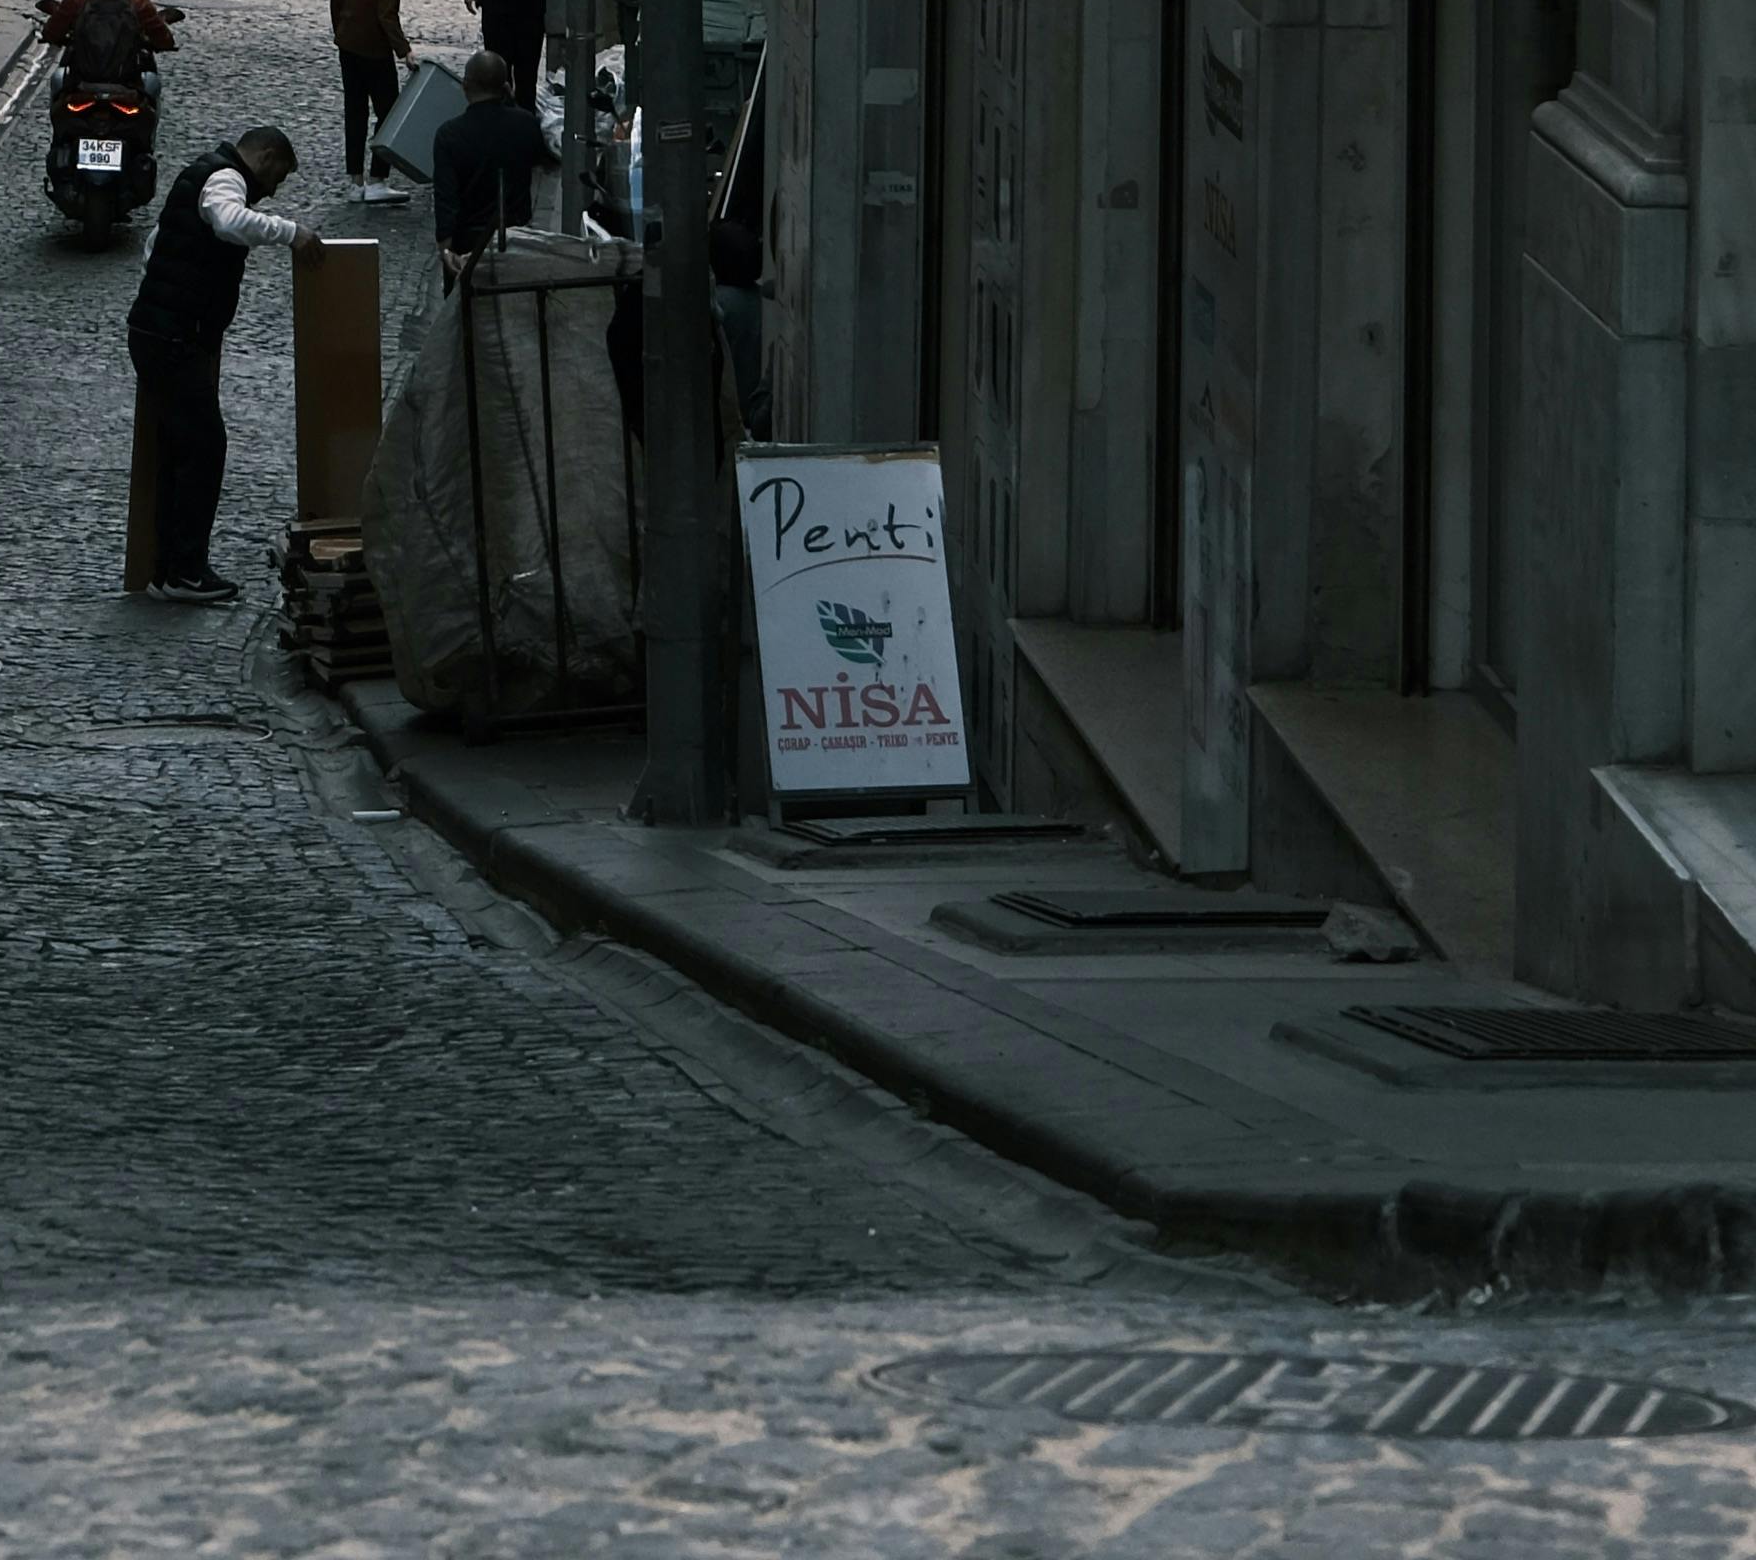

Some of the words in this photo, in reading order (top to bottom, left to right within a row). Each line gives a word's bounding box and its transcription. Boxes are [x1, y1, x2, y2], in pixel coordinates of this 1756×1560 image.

[749, 476, 934, 561] Penti
[776, 671, 951, 729] NİSA
[777, 736, 810, 754] ÇORAP
[820, 734, 867, 752] ÇAMAŞIR
[925, 731, 959, 746] PENYE
